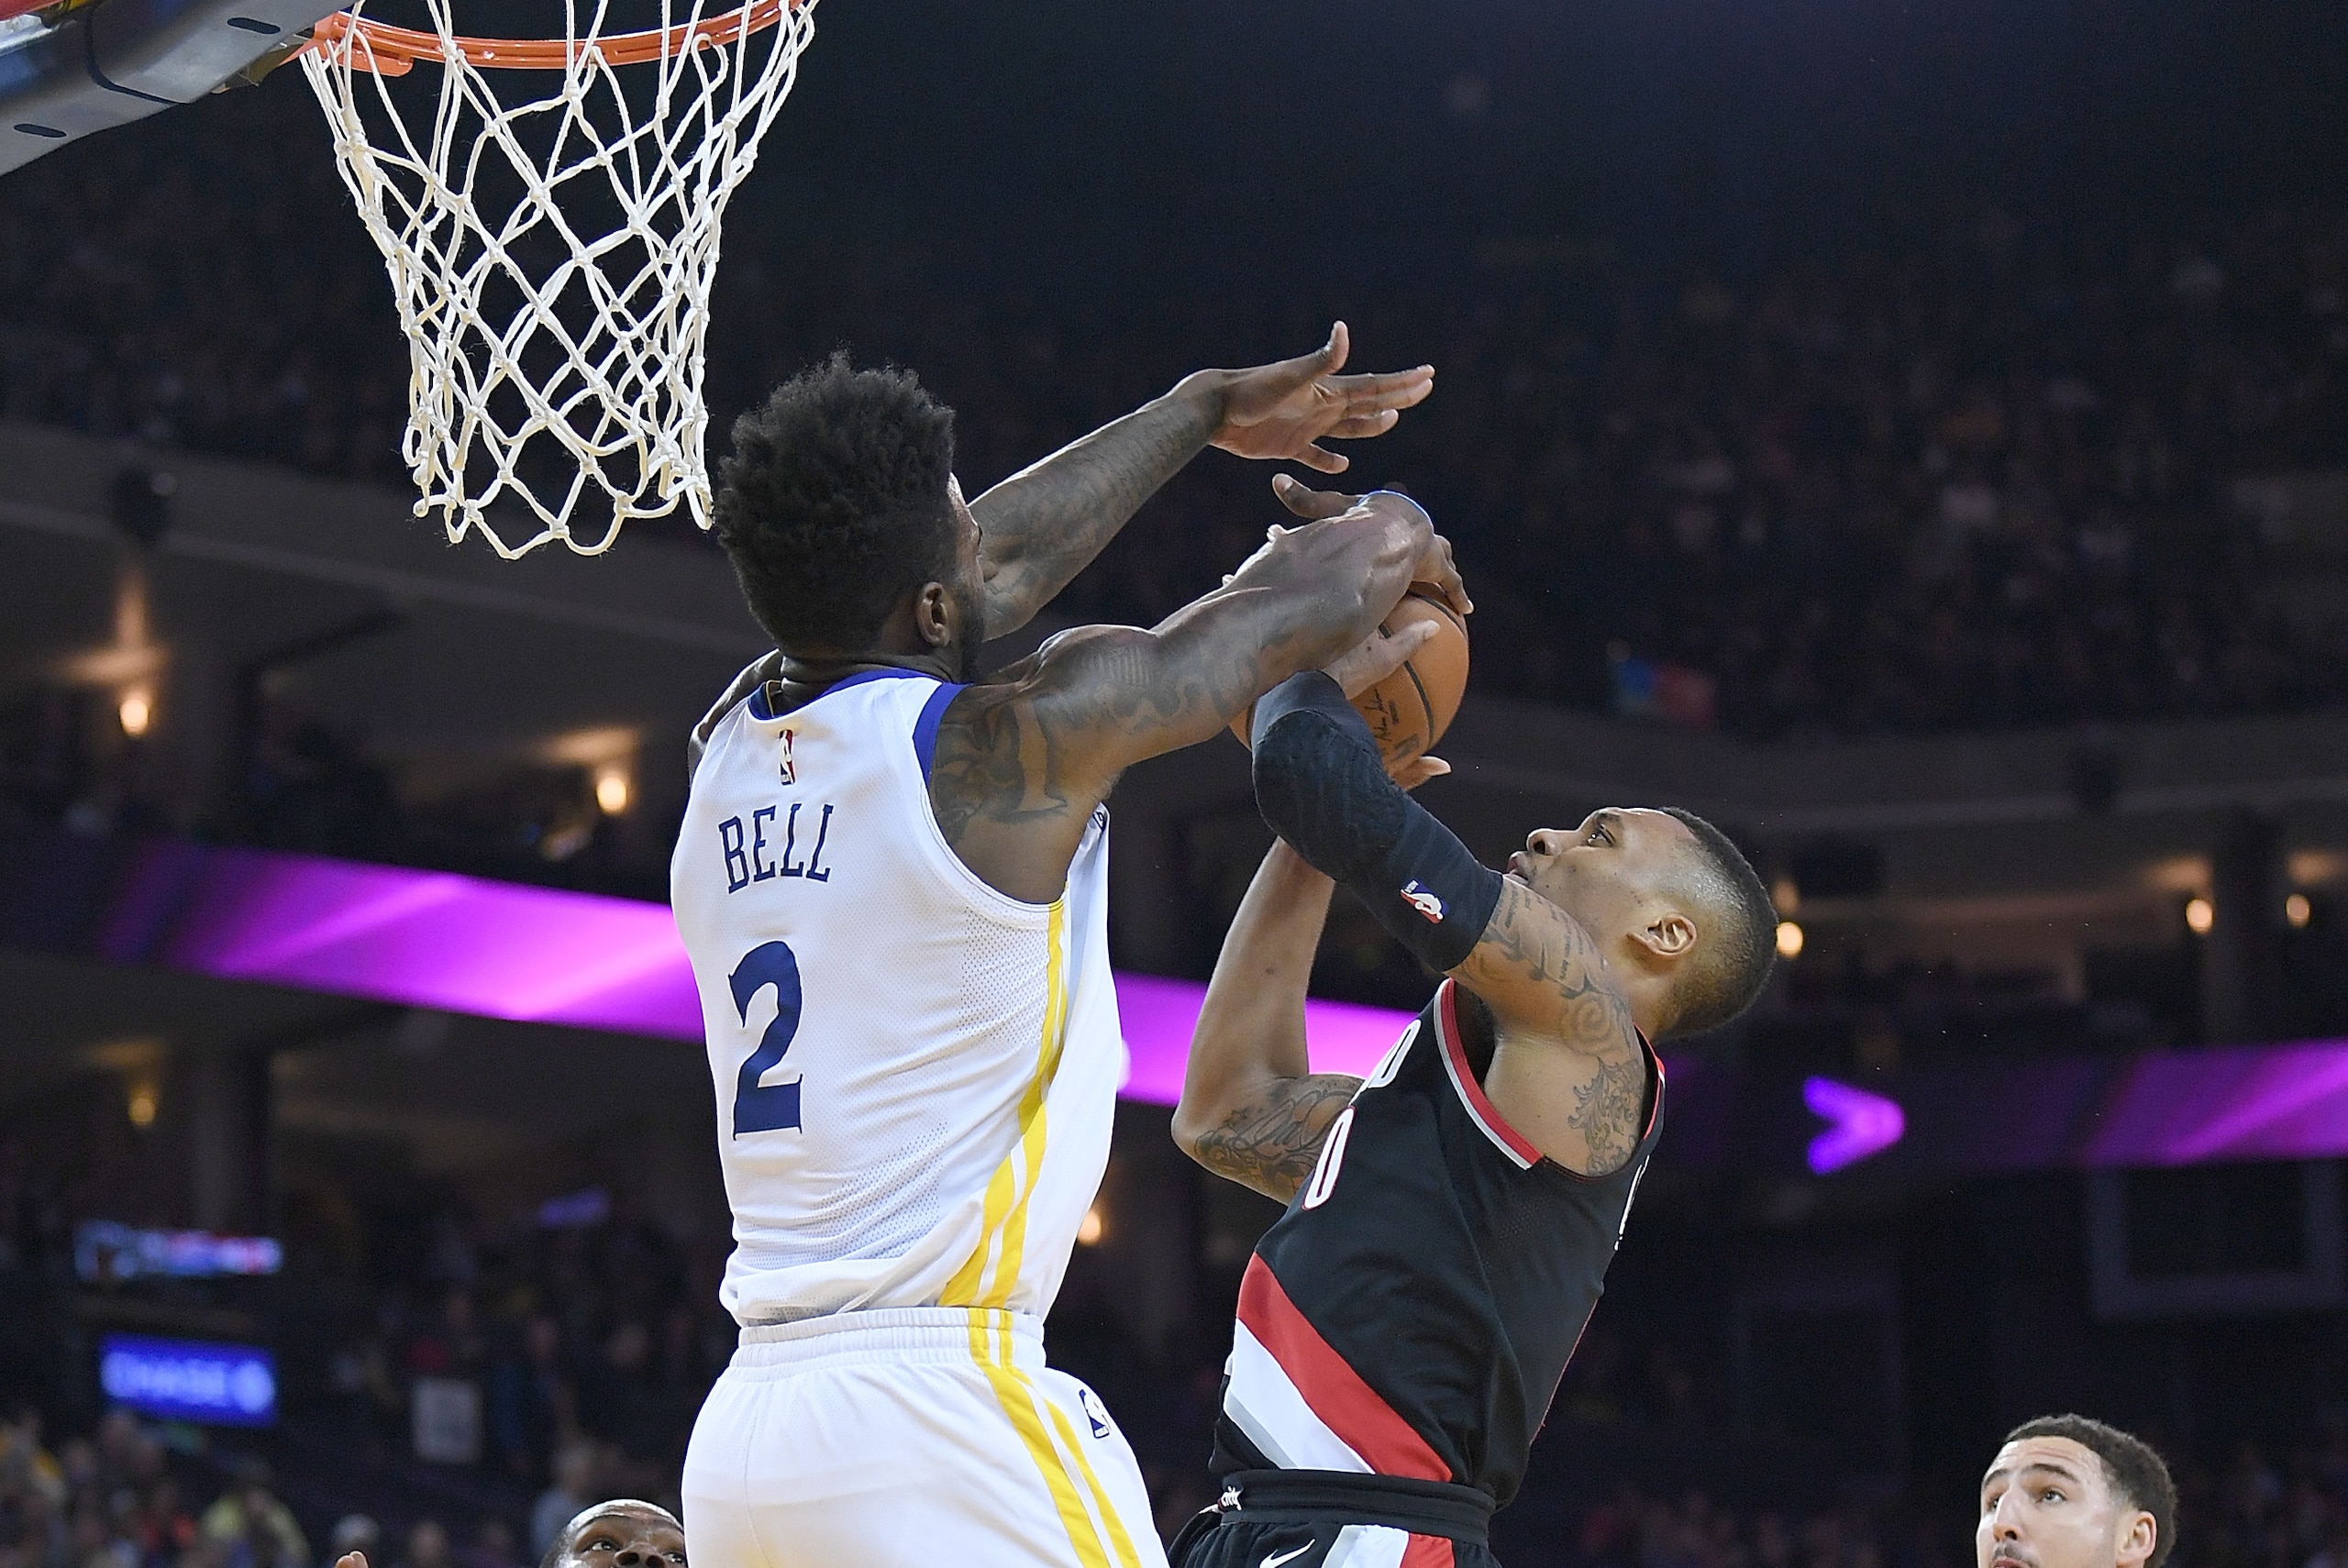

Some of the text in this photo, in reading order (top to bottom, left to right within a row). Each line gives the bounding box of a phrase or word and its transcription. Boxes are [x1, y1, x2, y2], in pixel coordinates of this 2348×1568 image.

[718, 803, 834, 894] BELL
[727, 940, 803, 1141] 2
[1302, 1105, 1357, 1210] 0
